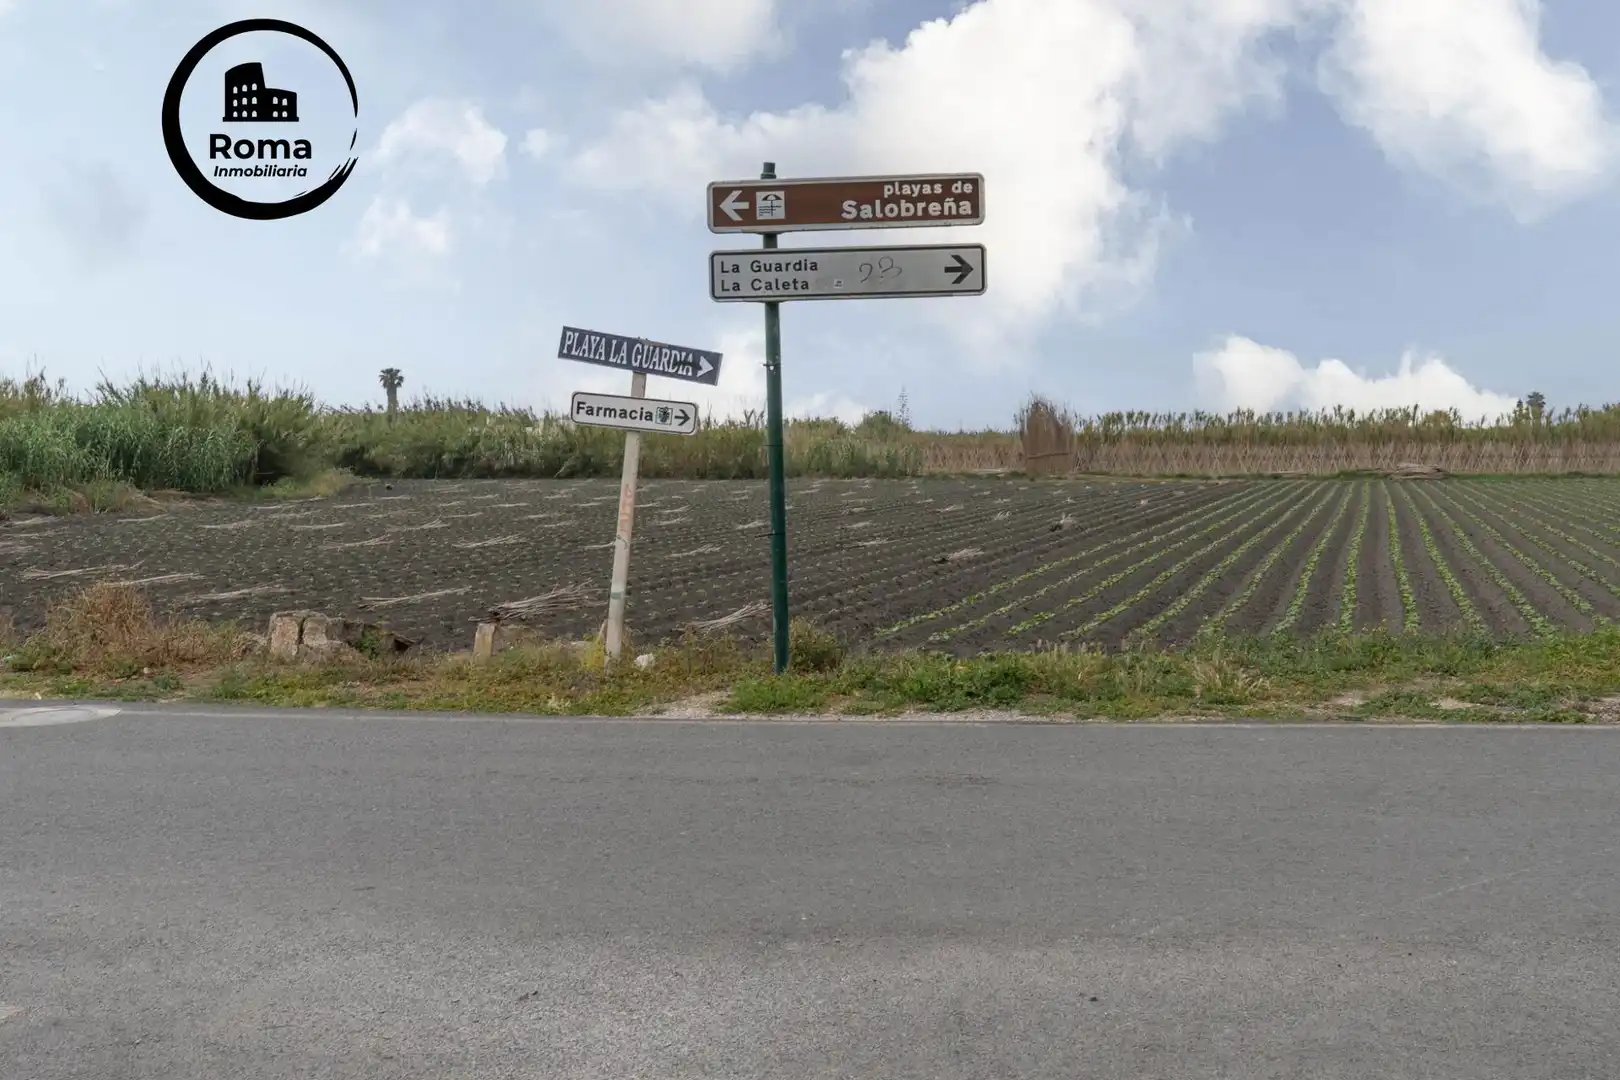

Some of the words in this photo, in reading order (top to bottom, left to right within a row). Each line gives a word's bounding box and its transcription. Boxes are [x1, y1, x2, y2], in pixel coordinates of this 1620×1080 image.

[883, 181, 943, 198] playas
[951, 179, 974, 194] de
[841, 195, 974, 220] Salobreña
[720, 260, 741, 274] La
[750, 258, 819, 273] Guardia
[721, 278, 741, 293] La
[750, 277, 810, 292] Caleta
[562, 331, 606, 361] PLAYA
[609, 339, 628, 365] LA
[631, 342, 694, 377] GUARDIA
[576, 401, 654, 422] Farmacia
